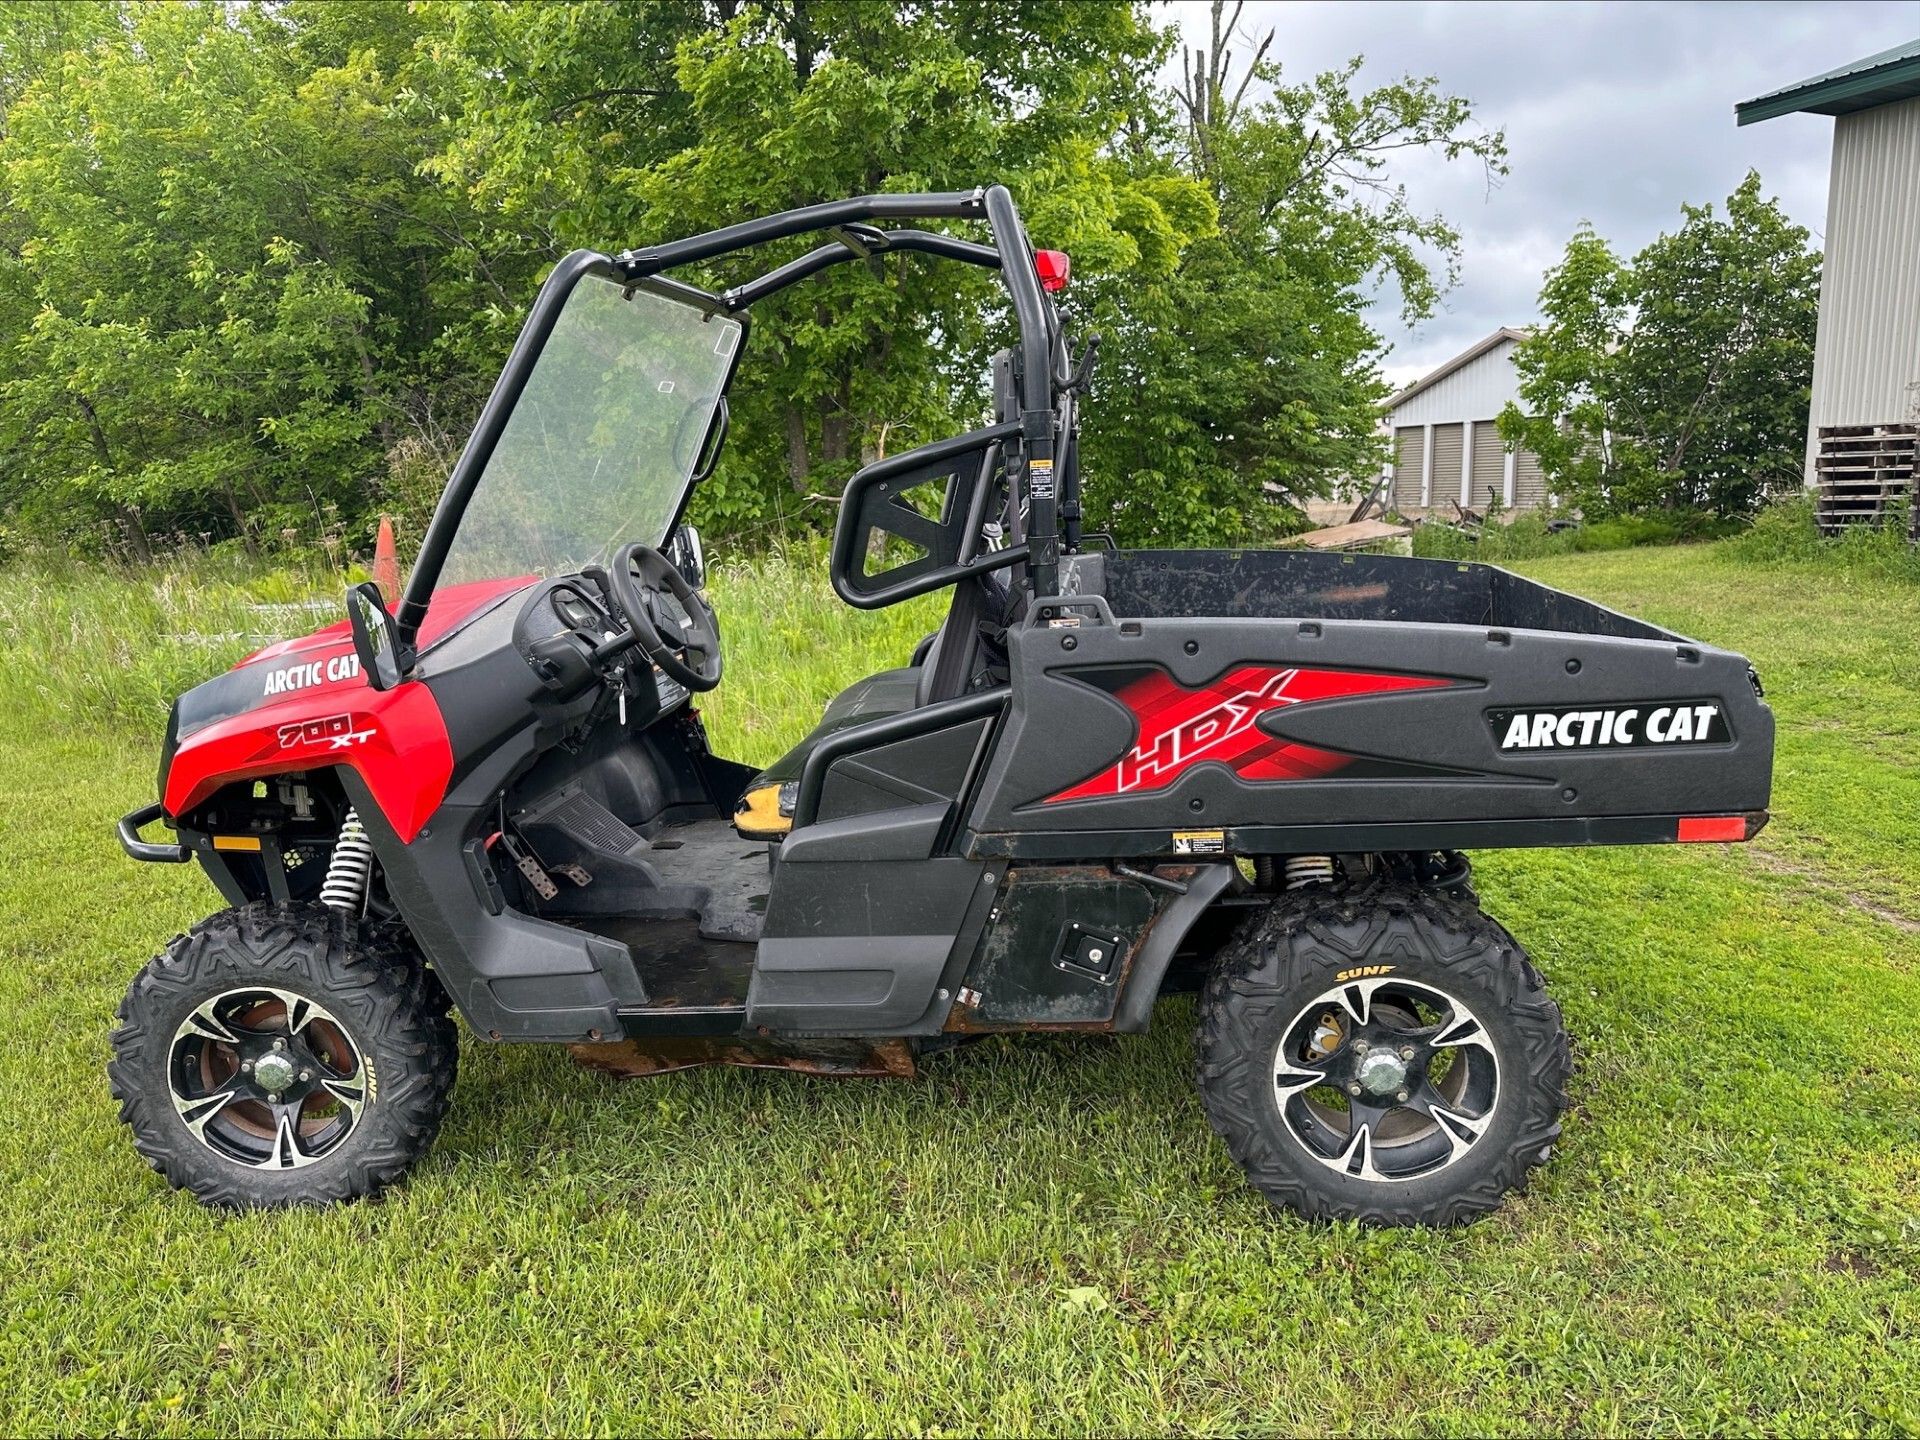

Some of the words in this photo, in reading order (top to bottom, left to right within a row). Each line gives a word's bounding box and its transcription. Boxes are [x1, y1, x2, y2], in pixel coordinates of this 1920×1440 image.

[263, 661, 322, 695] ARCTIC
[327, 653, 359, 682] CAT
[277, 712, 353, 748] 700
[329, 729, 376, 749] XT
[1117, 668, 1302, 793] HDX
[1502, 709, 1638, 748] ARCTIC
[1646, 705, 1718, 742] CAT
[1333, 965, 1397, 982] SUNF
[363, 1052, 377, 1104] SUNF
